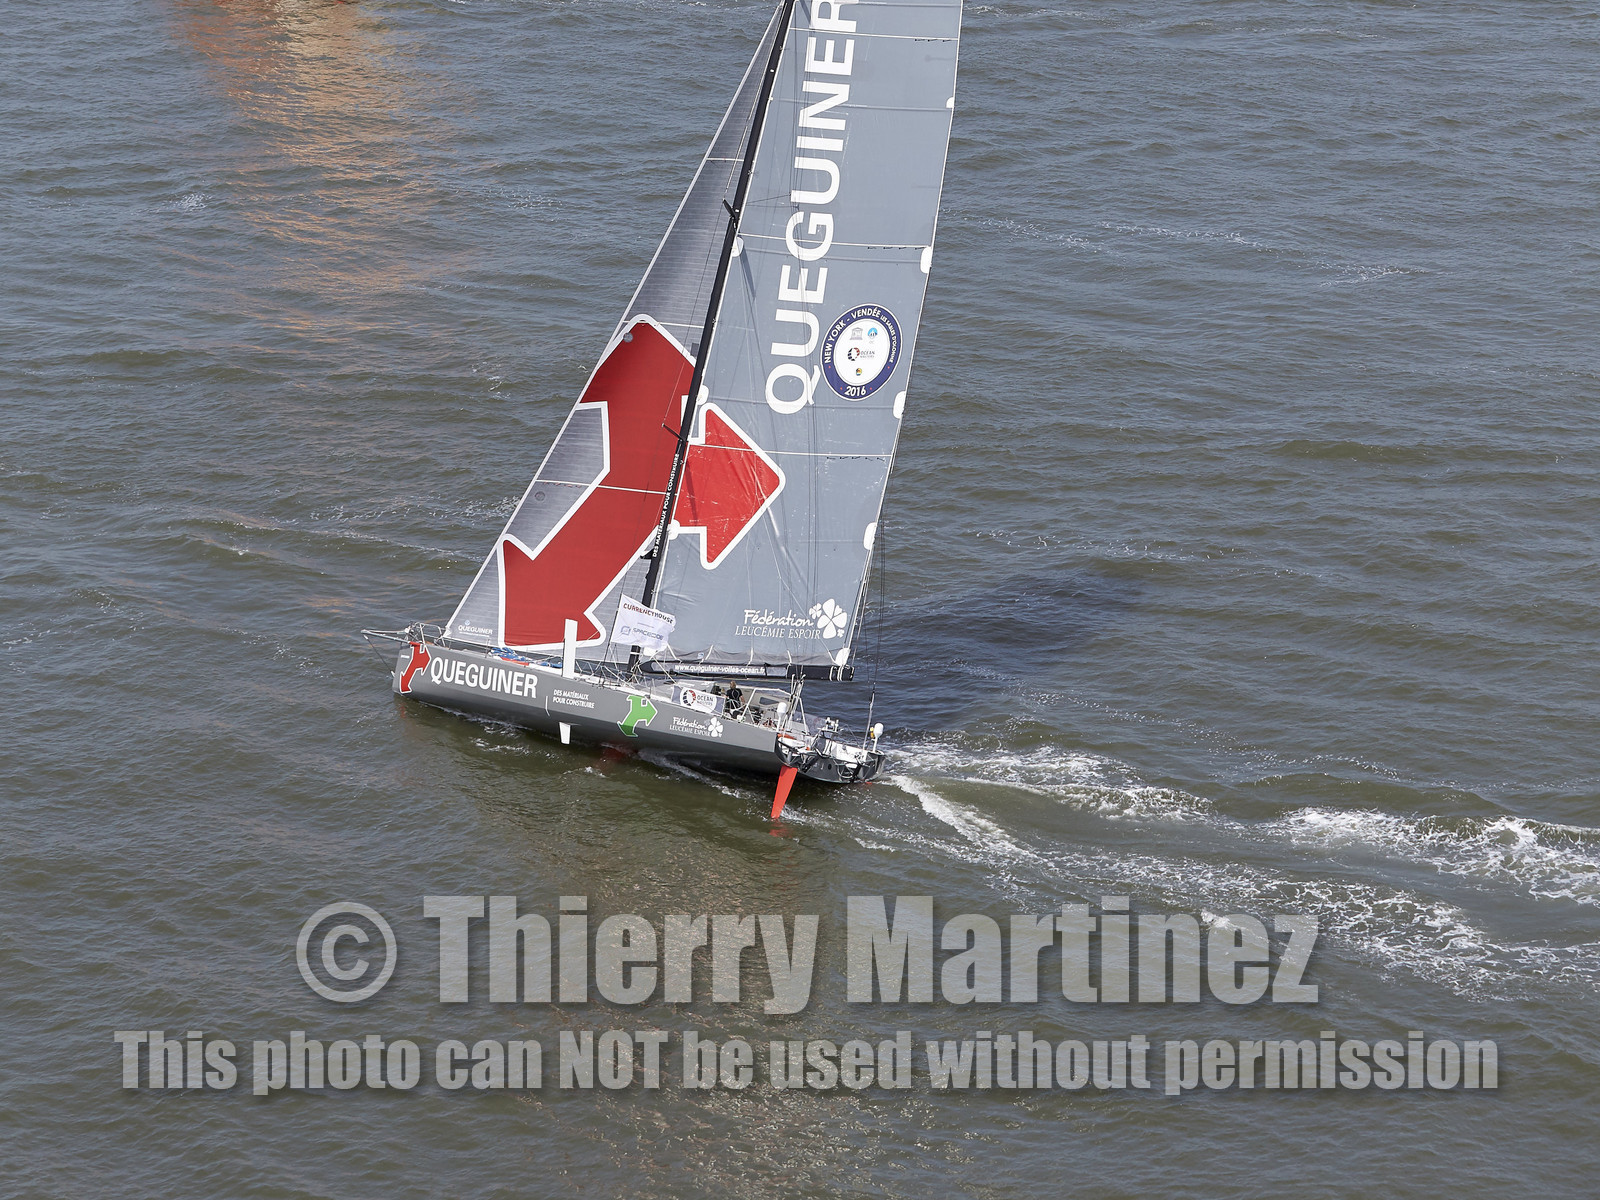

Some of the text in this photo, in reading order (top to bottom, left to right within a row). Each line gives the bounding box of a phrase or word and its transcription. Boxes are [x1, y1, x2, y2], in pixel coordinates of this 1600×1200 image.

[850, 306, 881, 320] VENDÉE
[828, 319, 847, 343] YORK
[824, 343, 833, 364] NEW
[844, 386, 867, 397] 2016
[652, 542, 661, 558] DES
[663, 492, 671, 510] POUR
[667, 453, 680, 491] CONSTRUIRE
[743, 609, 814, 628] Fédération
[458, 625, 493, 635] QUEGUINER
[735, 625, 821, 640] LEUCÉMIE ESPOIR
[430, 656, 538, 699] QUEGUINER
[552, 696, 595, 709] POUR CONSTRUIRE
[562, 690, 590, 700] MATÉRIAUX
